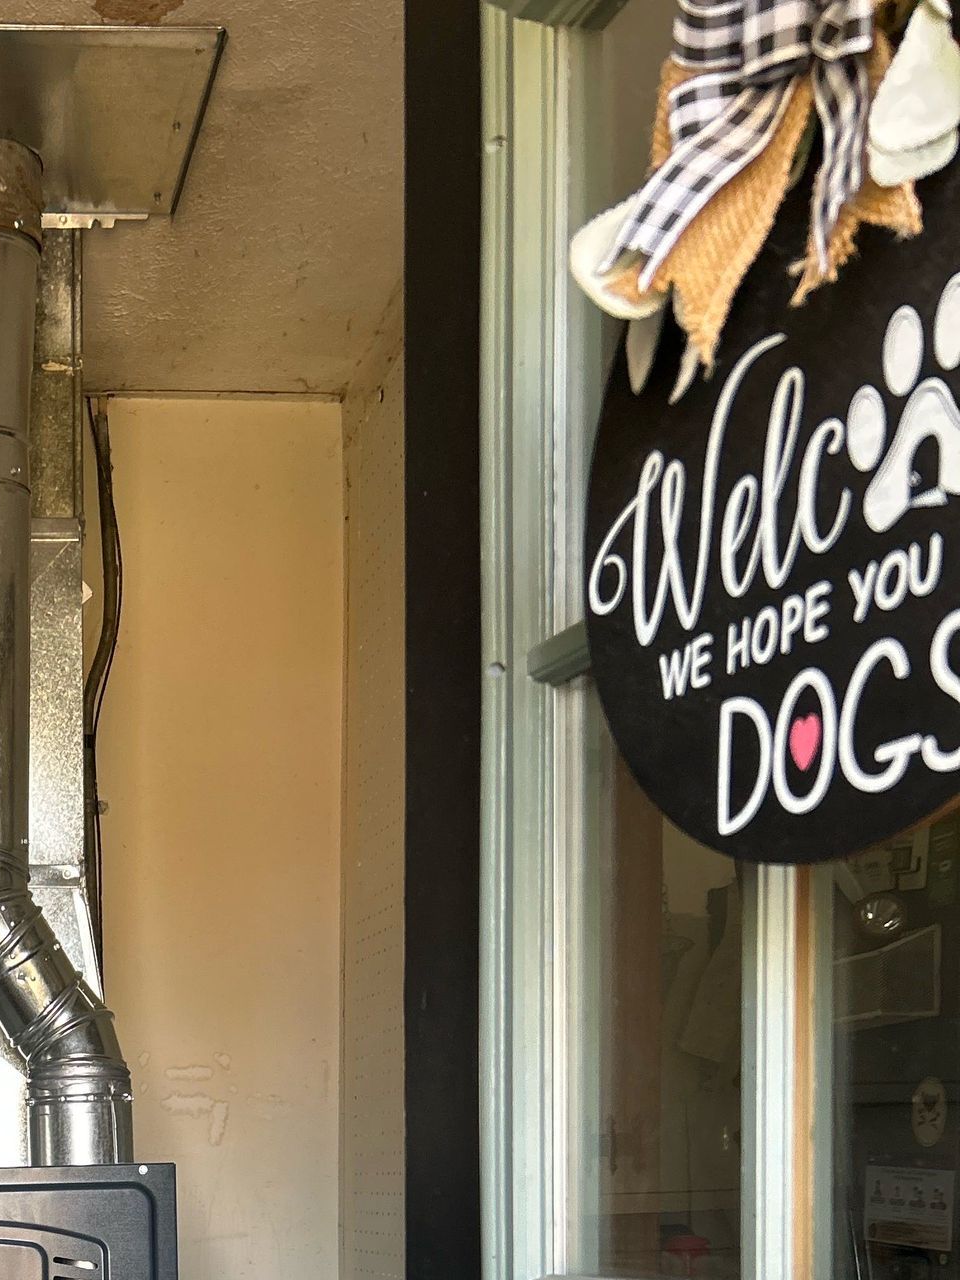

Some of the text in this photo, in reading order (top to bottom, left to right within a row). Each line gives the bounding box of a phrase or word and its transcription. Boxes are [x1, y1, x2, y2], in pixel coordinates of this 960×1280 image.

[658, 533, 944, 700] WE HOPE YOU
